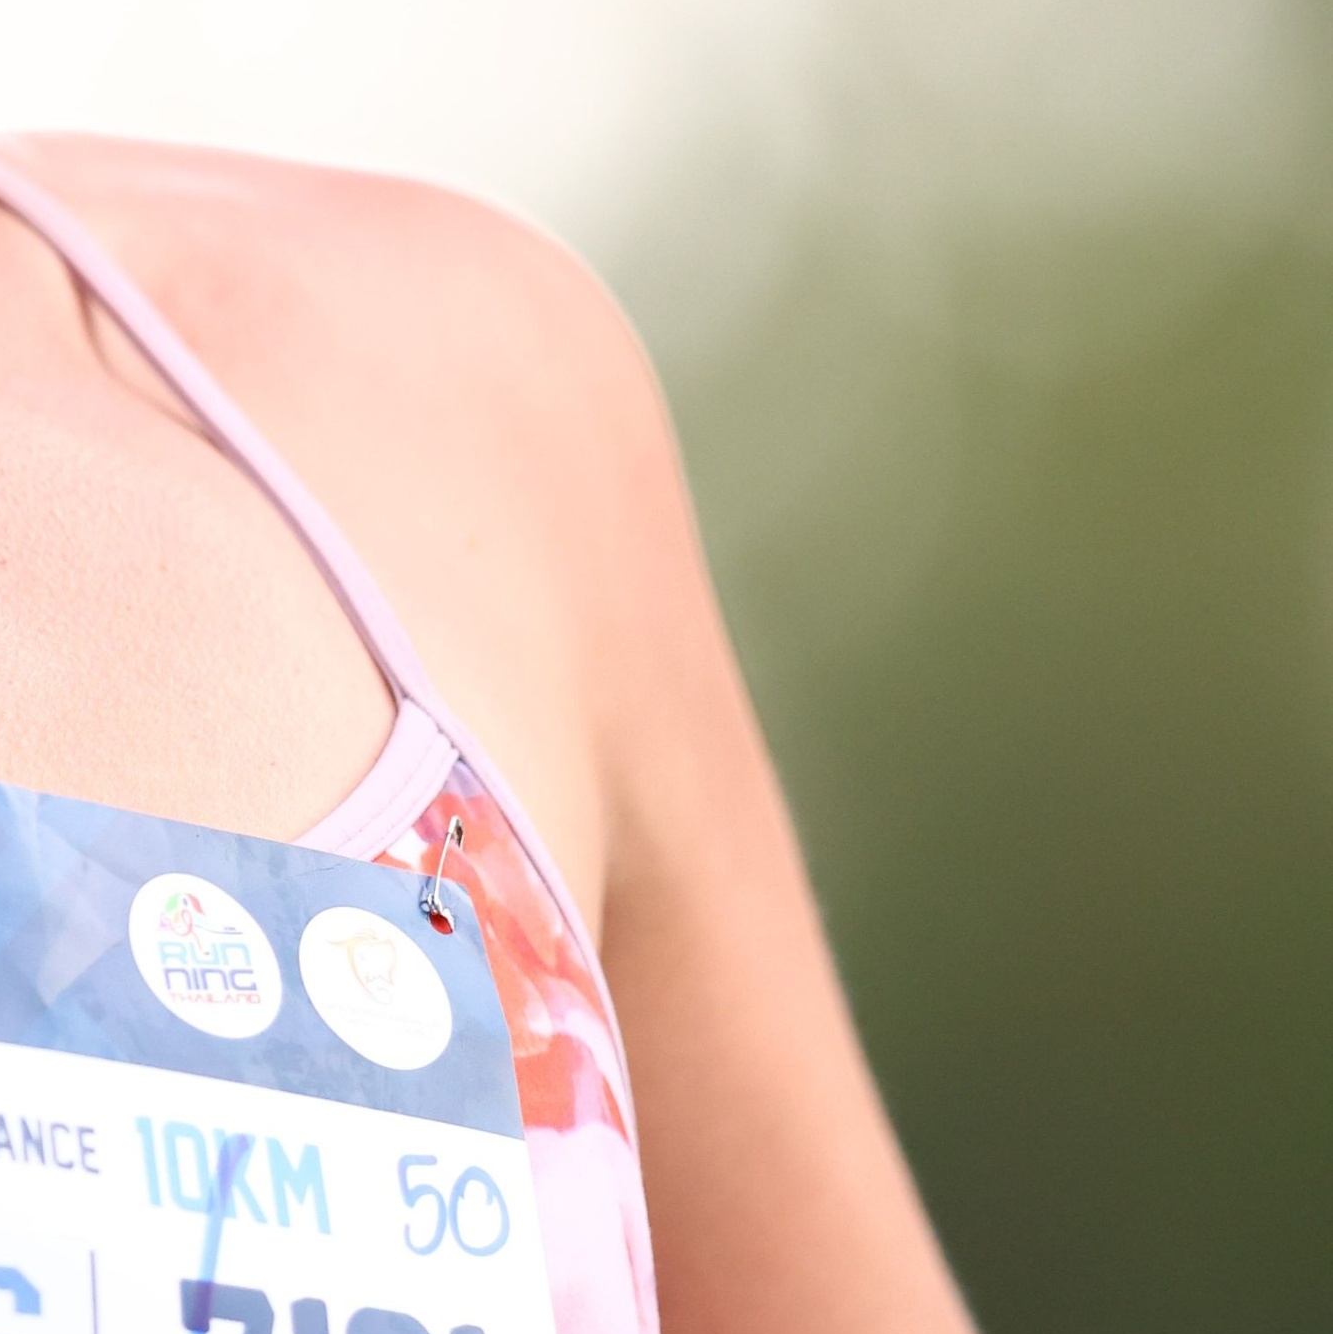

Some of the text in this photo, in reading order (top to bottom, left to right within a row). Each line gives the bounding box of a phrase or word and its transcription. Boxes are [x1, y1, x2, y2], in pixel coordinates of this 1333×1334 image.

[169, 992, 262, 1005] THAILAND
[135, 1115, 331, 1236] 10KM
[397, 1153, 512, 1258] 50
